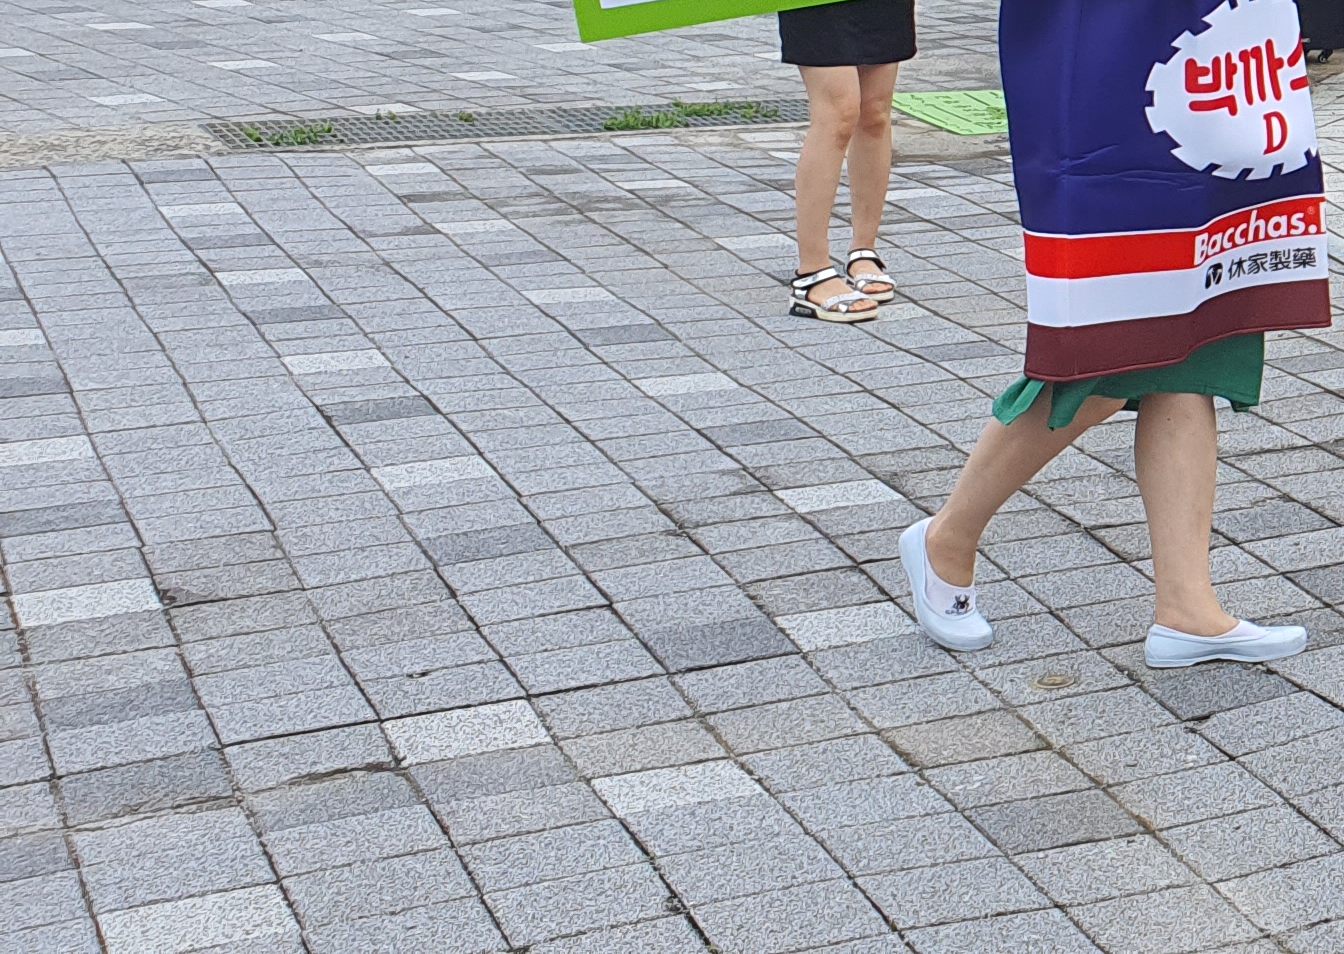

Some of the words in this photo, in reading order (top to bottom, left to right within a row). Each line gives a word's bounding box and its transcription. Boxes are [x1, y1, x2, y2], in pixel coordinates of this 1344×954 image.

[1262, 111, 1288, 155] D
[1228, 247, 1317, 281] 休家製藥
